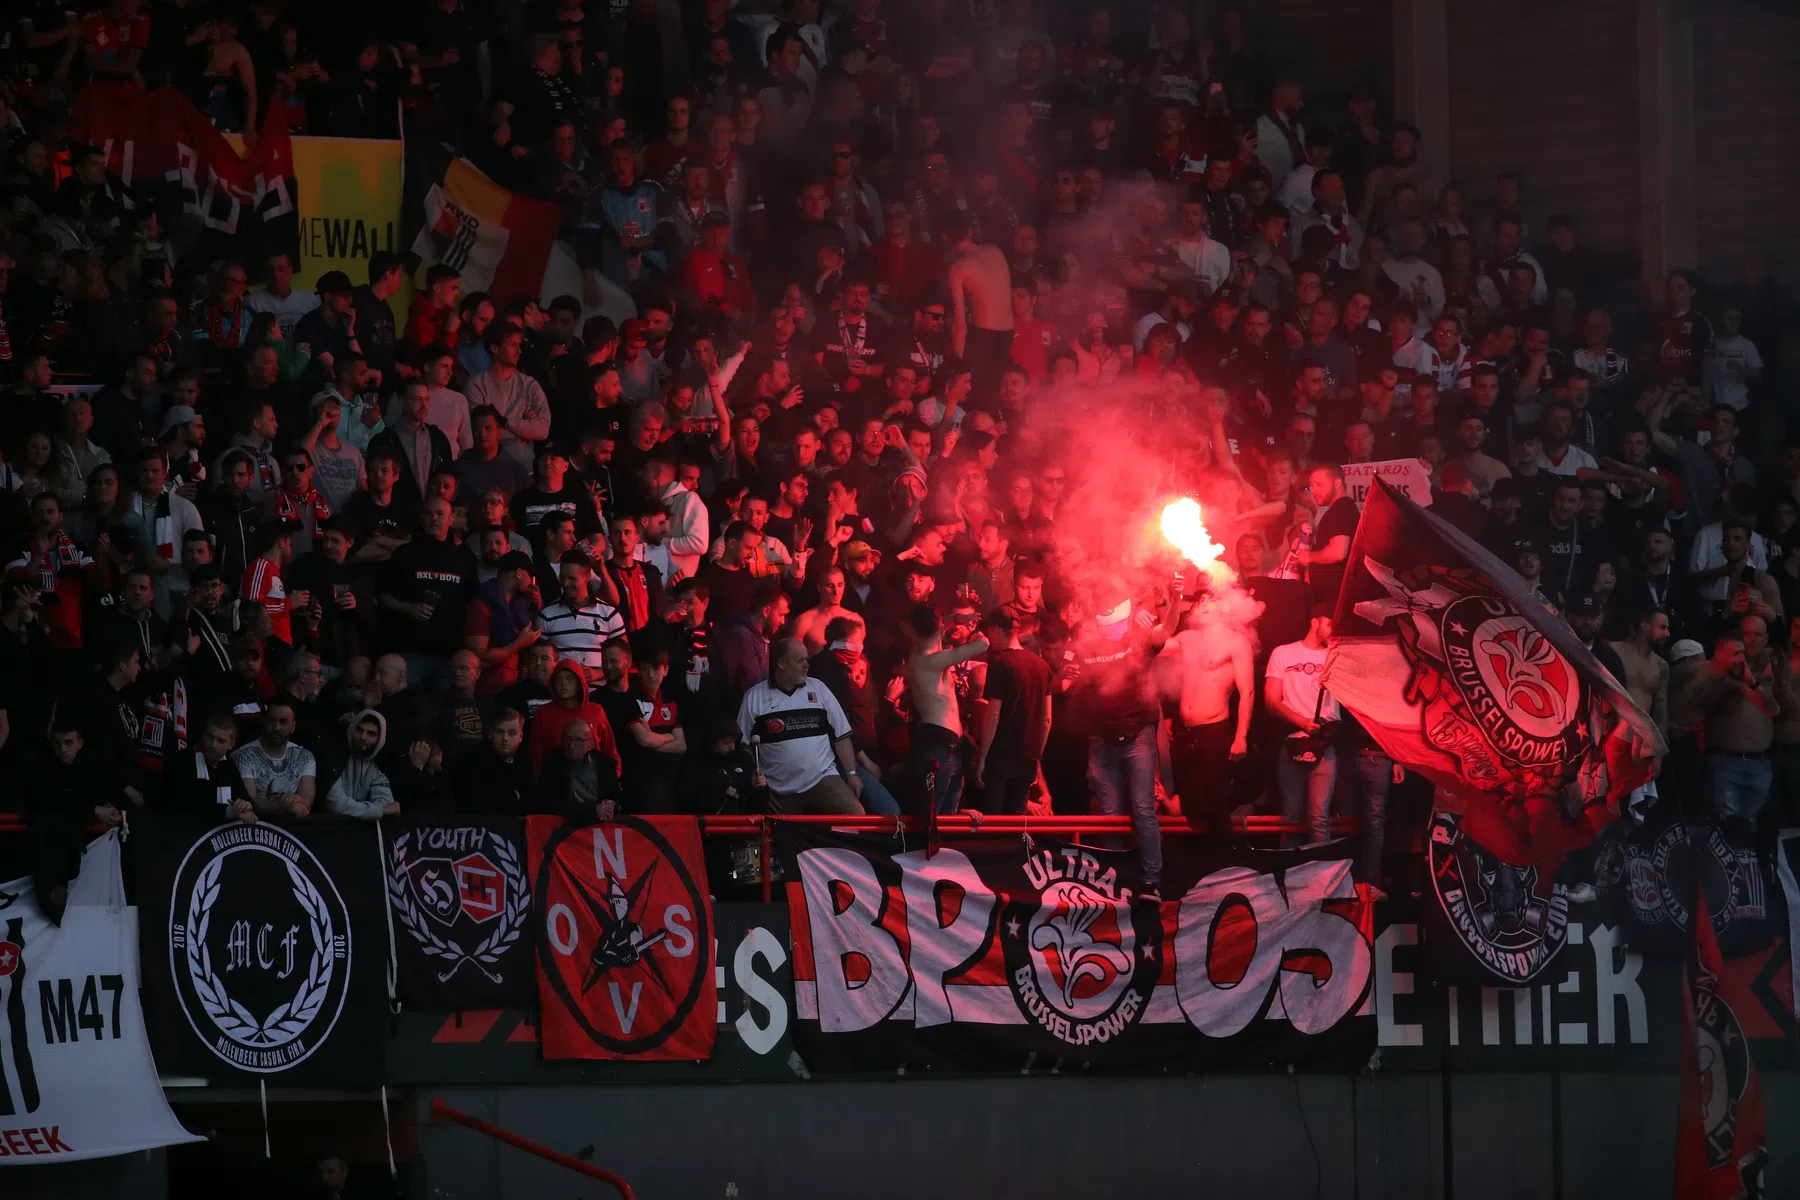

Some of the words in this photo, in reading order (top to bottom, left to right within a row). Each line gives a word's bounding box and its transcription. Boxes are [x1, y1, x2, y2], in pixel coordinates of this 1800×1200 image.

[1549, 542, 1582, 554] adids
[416, 571, 433, 580] BXL
[440, 571, 461, 584] BOYS
[211, 827, 253, 853] MOLENBEEK
[255, 828, 282, 850] CASUAL
[282, 839, 301, 863] FIRM
[416, 826, 486, 851] YOUTH
[592, 828, 628, 880] N
[173, 923, 185, 949] 2016
[333, 934, 346, 959] 2016
[663, 903, 695, 958] S
[38, 974, 124, 1045] M47
[608, 981, 643, 1034] V
[1014, 964, 1144, 1046] BRUSSELSPOWER
[216, 1036, 258, 1067] MOLENBEEK
[259, 1048, 288, 1067] CASUAL
[287, 1038, 306, 1060] FIRM
